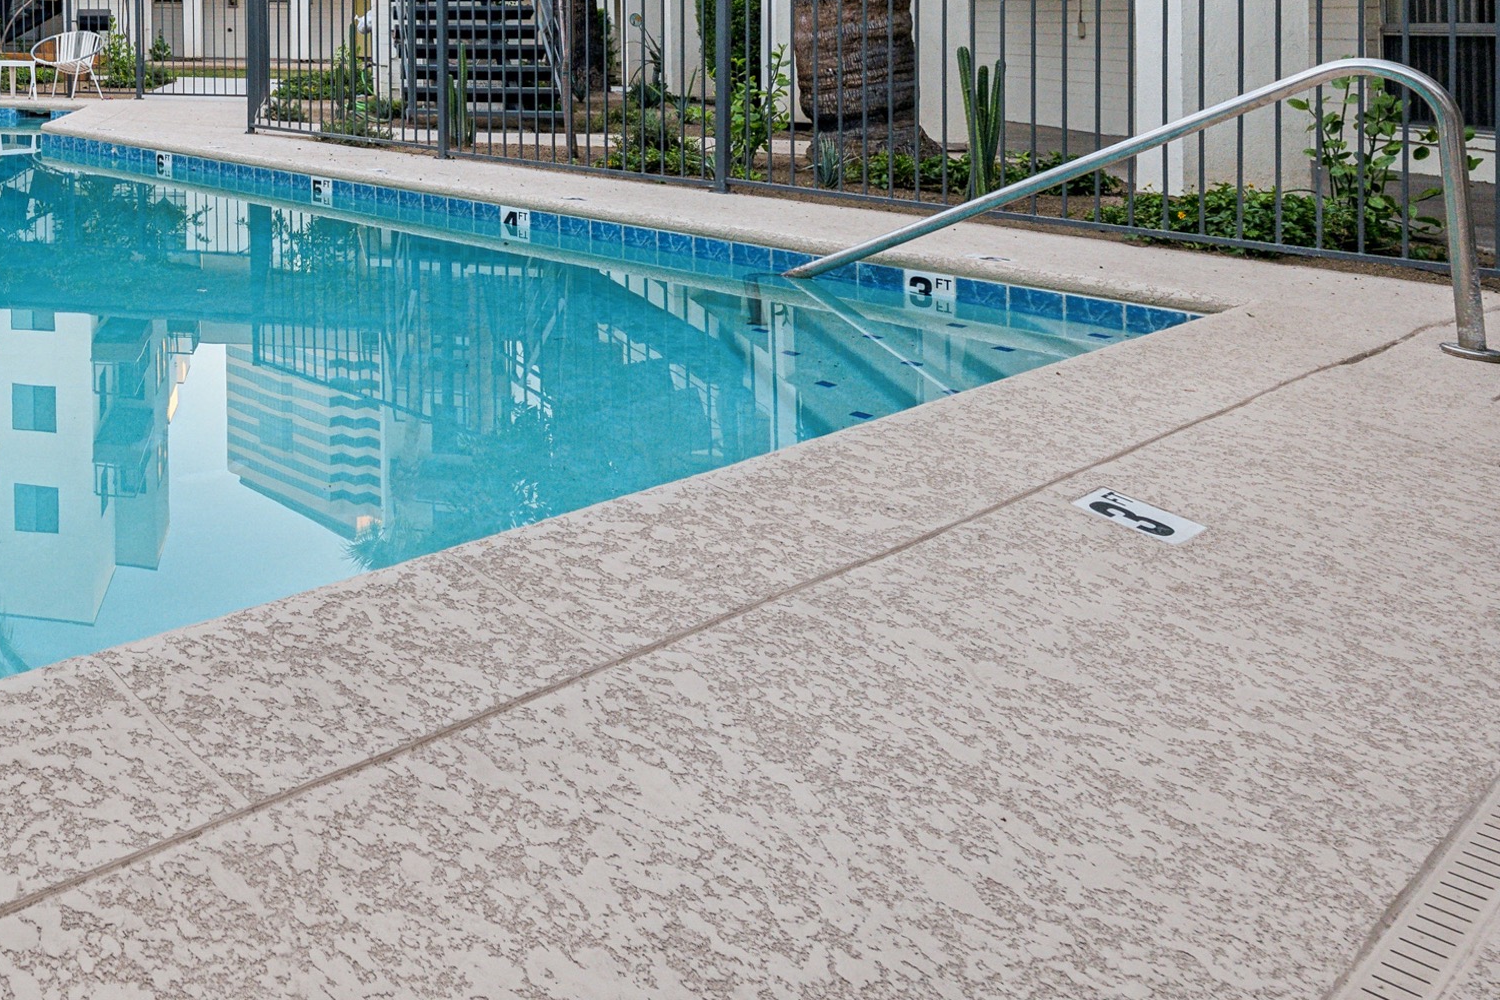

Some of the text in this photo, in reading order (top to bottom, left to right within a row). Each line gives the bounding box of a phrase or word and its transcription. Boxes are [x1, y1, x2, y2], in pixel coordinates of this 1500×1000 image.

[518, 212, 528, 221] FT
[909, 276, 952, 306] 3 FT
[1089, 501, 1175, 536] 3
